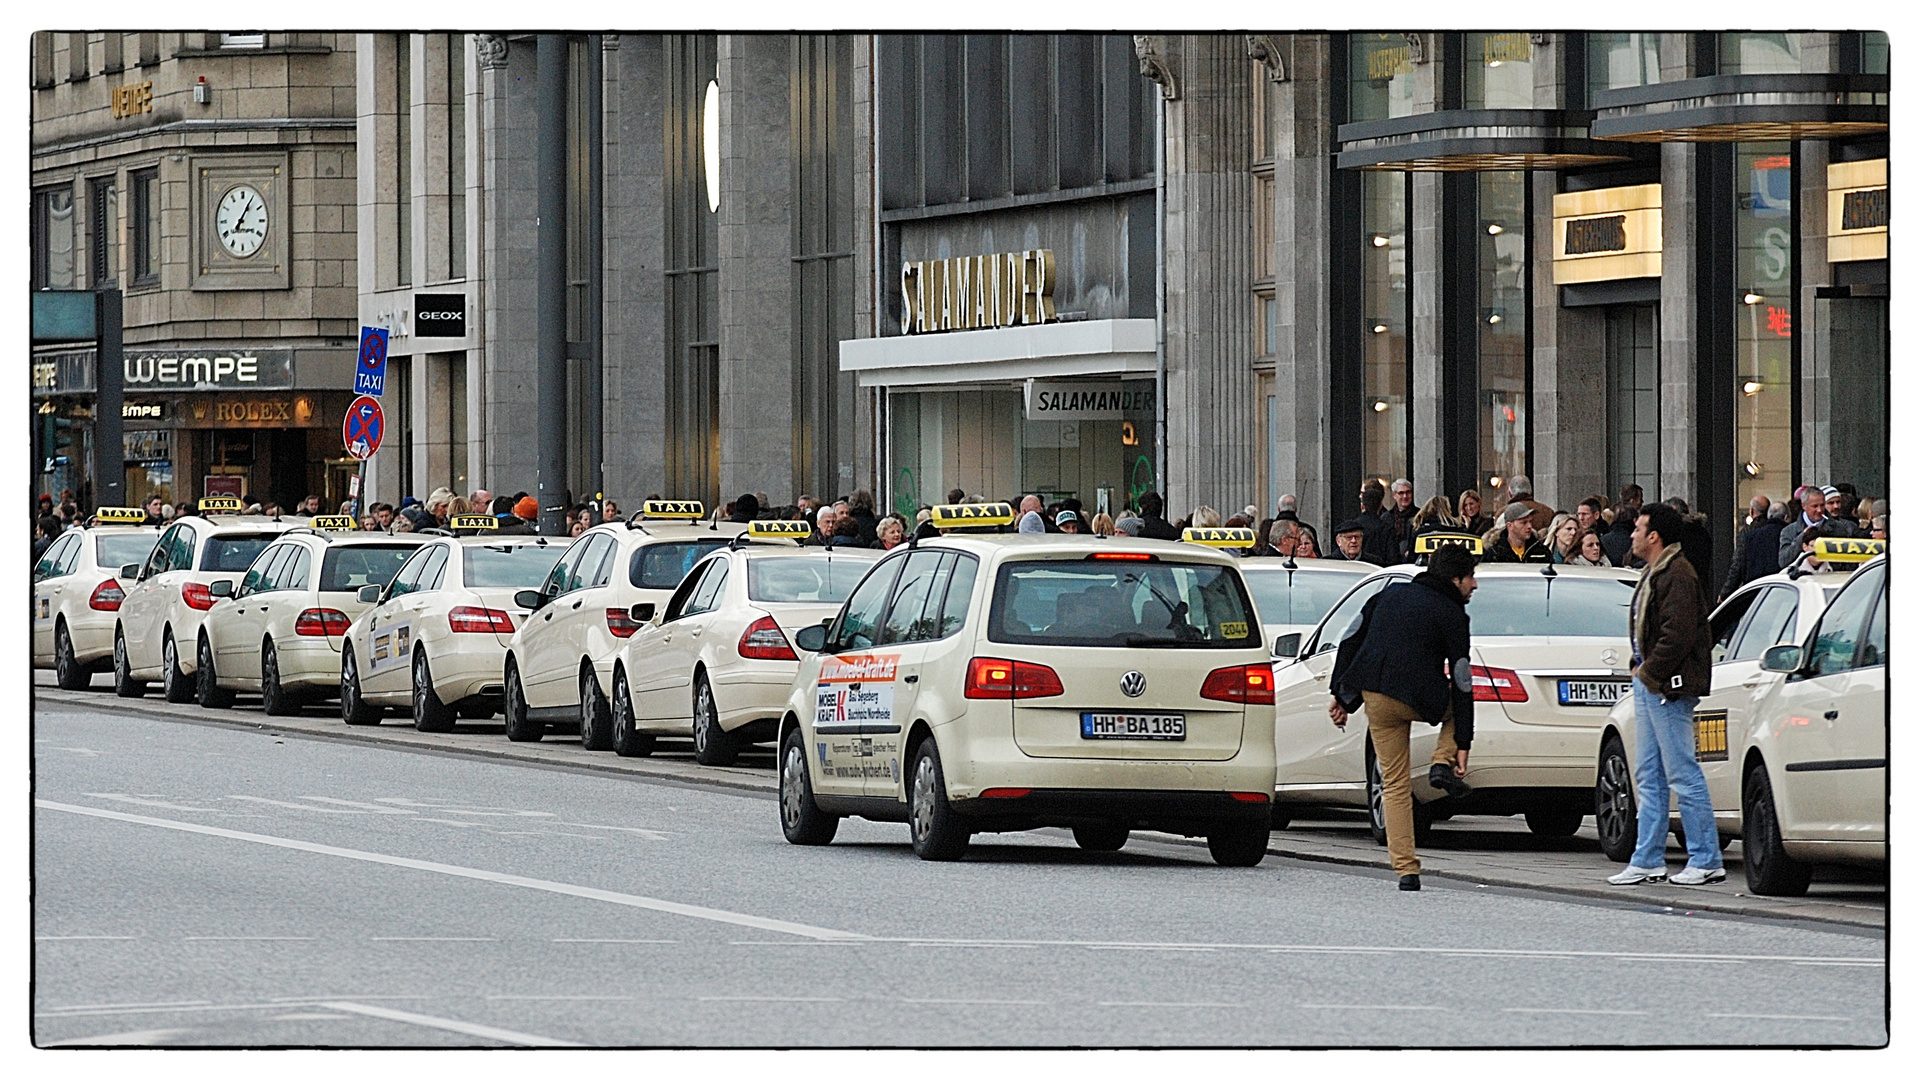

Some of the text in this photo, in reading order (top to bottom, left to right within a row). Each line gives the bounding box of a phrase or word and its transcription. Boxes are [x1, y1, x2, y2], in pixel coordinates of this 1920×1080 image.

[112, 81, 153, 119] WEMPE
[901, 249, 1057, 335] SALAMANDER
[418, 311, 462, 320] GEOX
[124, 357, 257, 382] WEMPE
[358, 373, 382, 390] TAXI
[1037, 391, 1154, 411] SALAMANDER
[216, 401, 291, 421] ROLEX
[209, 500, 233, 508] TAXI
[655, 503, 695, 513] TAXI
[108, 509, 140, 517] TAXI
[947, 506, 1002, 518] TAXI
[318, 518, 349, 527] TAXI
[461, 518, 490, 527] TAXI
[760, 522, 803, 533] TAXI
[1197, 530, 1245, 540] TAXI
[1223, 624, 1247, 635] 2044
[858, 690, 879, 704] Segeberg
[1569, 684, 1588, 699] HH
[1599, 684, 1618, 699] KN
[818, 691, 837, 707] MÖBEL
[837, 691, 847, 721] K
[817, 708, 836, 722] KRAFT
[868, 708, 891, 720] Nordheide
[1094, 717, 1183, 734] HH BA 185
